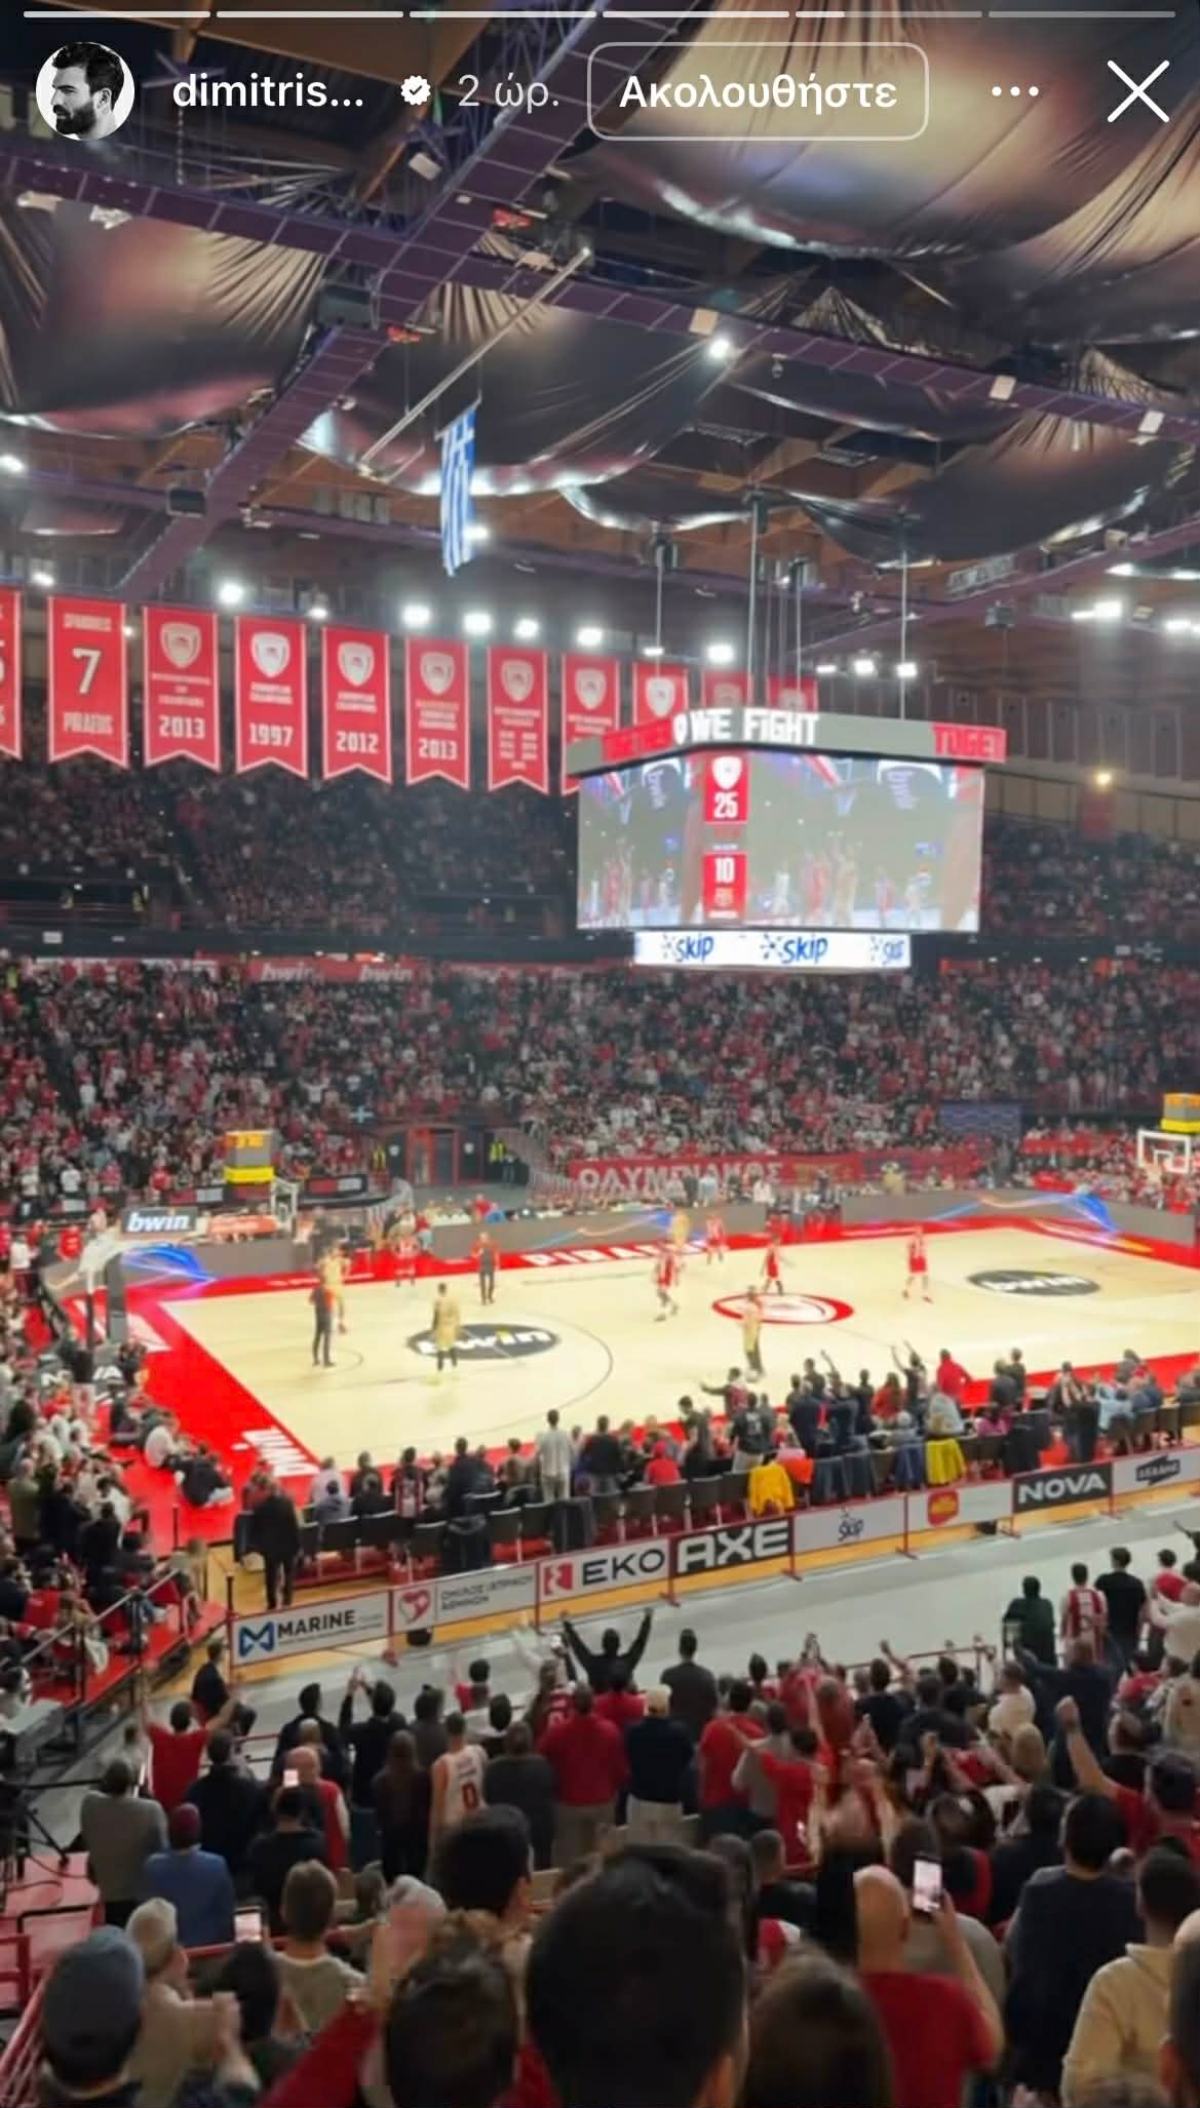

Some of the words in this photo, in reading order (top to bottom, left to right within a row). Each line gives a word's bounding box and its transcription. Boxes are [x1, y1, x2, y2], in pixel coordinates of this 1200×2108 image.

[72, 647, 102, 695] 7
[159, 714, 206, 740] 2013
[249, 722, 294, 748] 1997
[690, 707, 732, 741] WE
[336, 730, 379, 754] 2012
[418, 737, 458, 761] 2013
[713, 791, 739, 819] 25
[714, 857, 735, 884] 10
[127, 1211, 190, 1233] bwin
[1018, 1472, 1106, 1504] NOVA
[676, 1519, 790, 1574] AXE
[582, 1549, 665, 1586] EKO
[276, 1609, 357, 1640] MARINE
